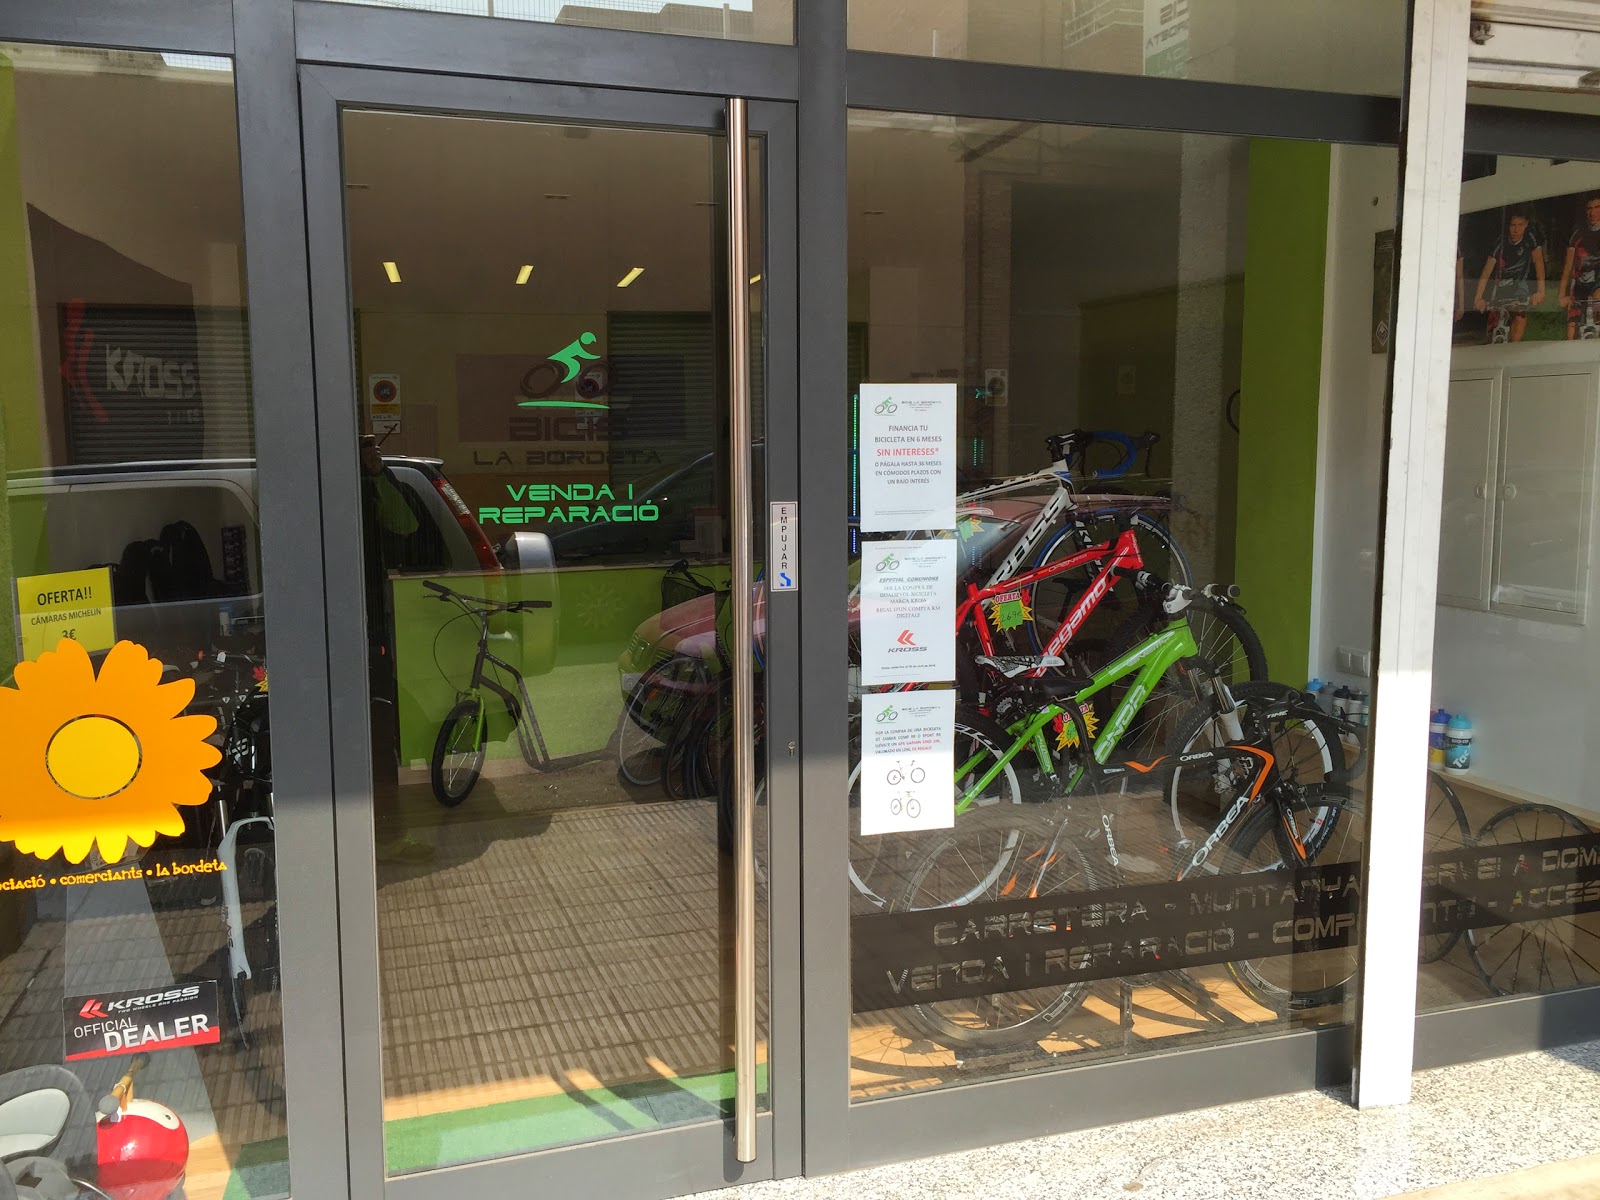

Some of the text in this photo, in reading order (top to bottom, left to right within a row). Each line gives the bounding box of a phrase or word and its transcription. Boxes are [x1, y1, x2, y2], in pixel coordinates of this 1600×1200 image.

[473, 450, 663, 466] LA BORDETA
[876, 448, 890, 456] SIN
[506, 483, 634, 501] VENDA I
[479, 500, 659, 524] REPARACIÓ
[780, 507, 788, 569] EMPUJAR
[37, 586, 93, 606] OFERTA!!
[995, 592, 1021, 603] OFERTA
[30, 607, 102, 626] CÁMARAS MICHELIN
[1040, 577, 1107, 663] egamo
[1266, 709, 1289, 719] TIME
[1179, 751, 1214, 762] ORBEA
[1102, 814, 1119, 867] ORBEA
[1192, 796, 1250, 867] ORBEA
[59, 866, 143, 886] comerciants
[156, 862, 171, 877] la
[172, 858, 228, 876] bordeta
[933, 899, 1149, 947] CARRETERA
[886, 955, 1010, 994] VENDA
[107, 985, 200, 1012] KROSS
[132, 1003, 157, 1011] WHEELS
[172, 995, 199, 1004] PASSION
[74, 1017, 138, 1039] OFFICIAL
[103, 1013, 210, 1052] DEALER
